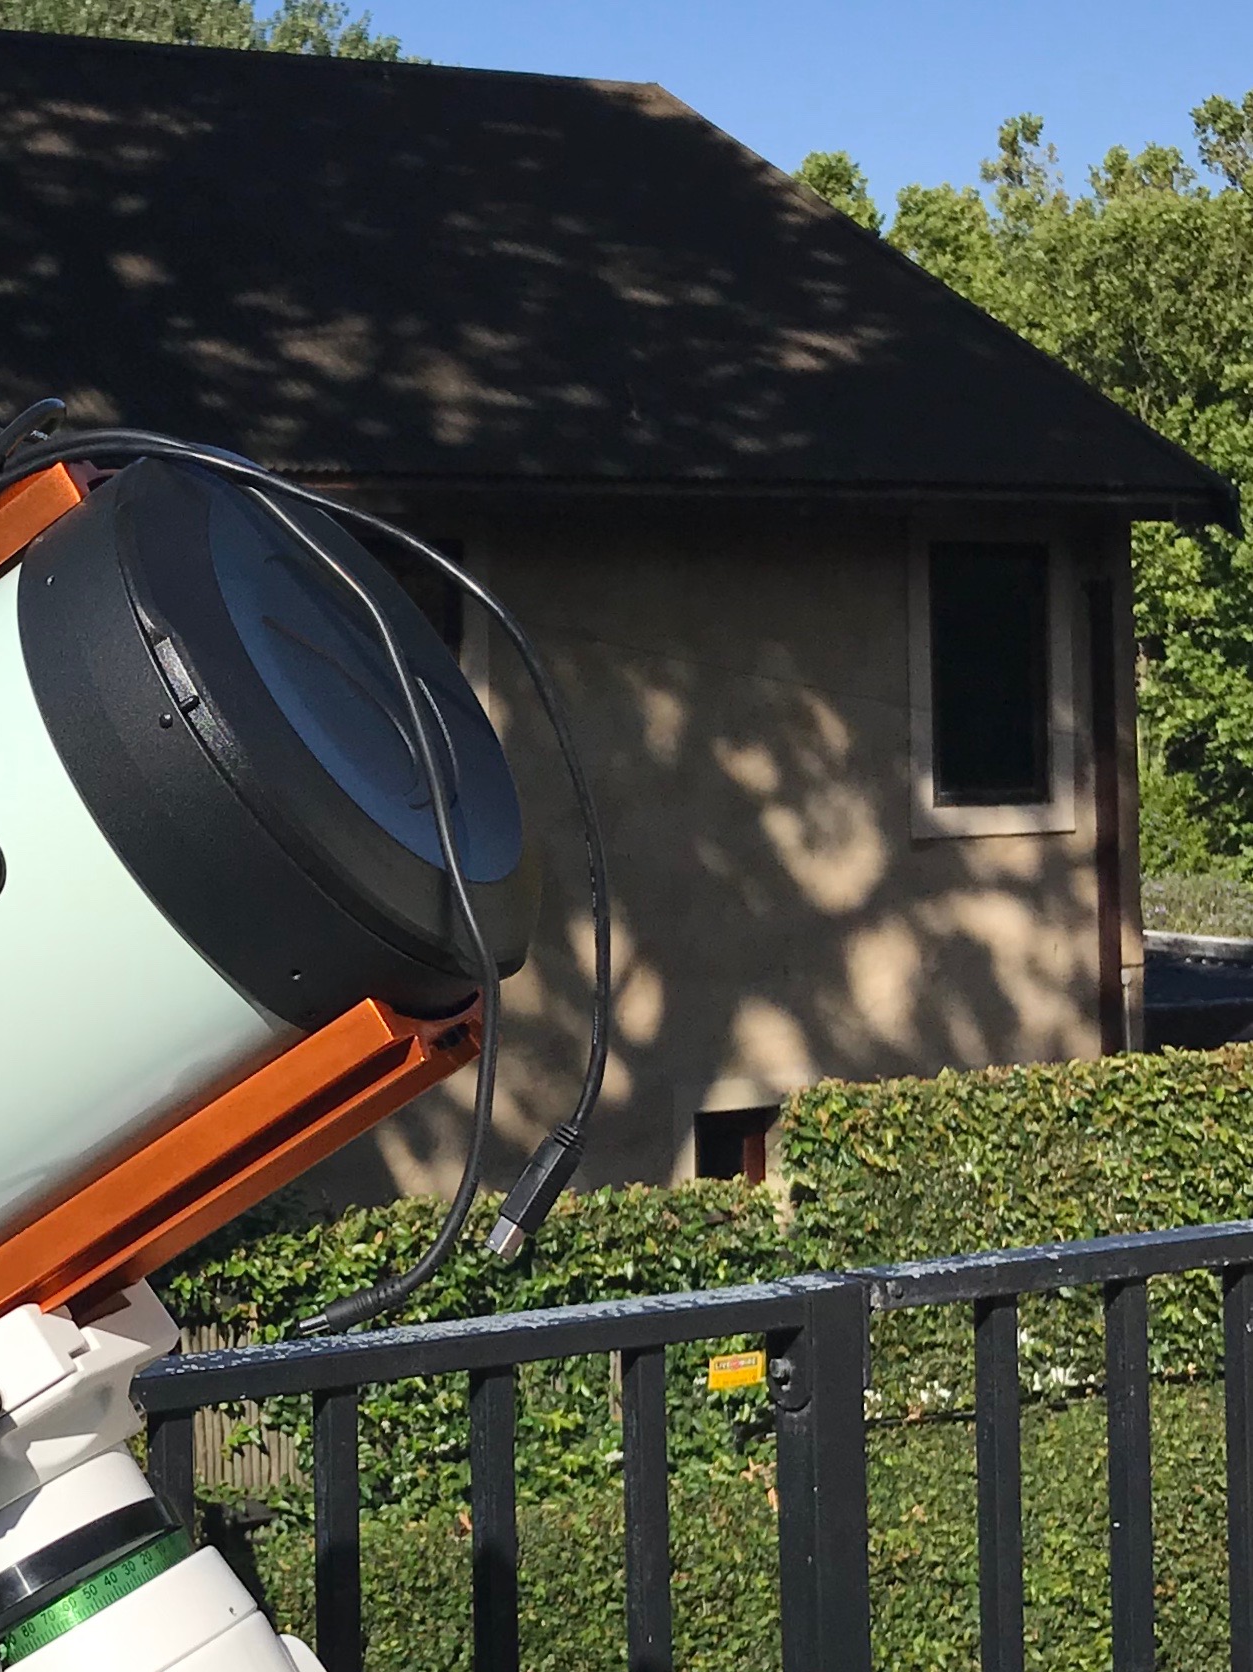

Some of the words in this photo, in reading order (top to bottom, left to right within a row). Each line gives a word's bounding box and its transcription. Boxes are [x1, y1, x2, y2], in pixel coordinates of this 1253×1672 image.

[21, 1622, 36, 1638] 80
[40, 1610, 56, 1625] 70
[62, 1597, 77, 1612] 60
[82, 1584, 98, 1600] 50
[104, 1572, 119, 1586] 40
[121, 1560, 136, 1576] 30
[139, 1551, 154, 1566] 20
